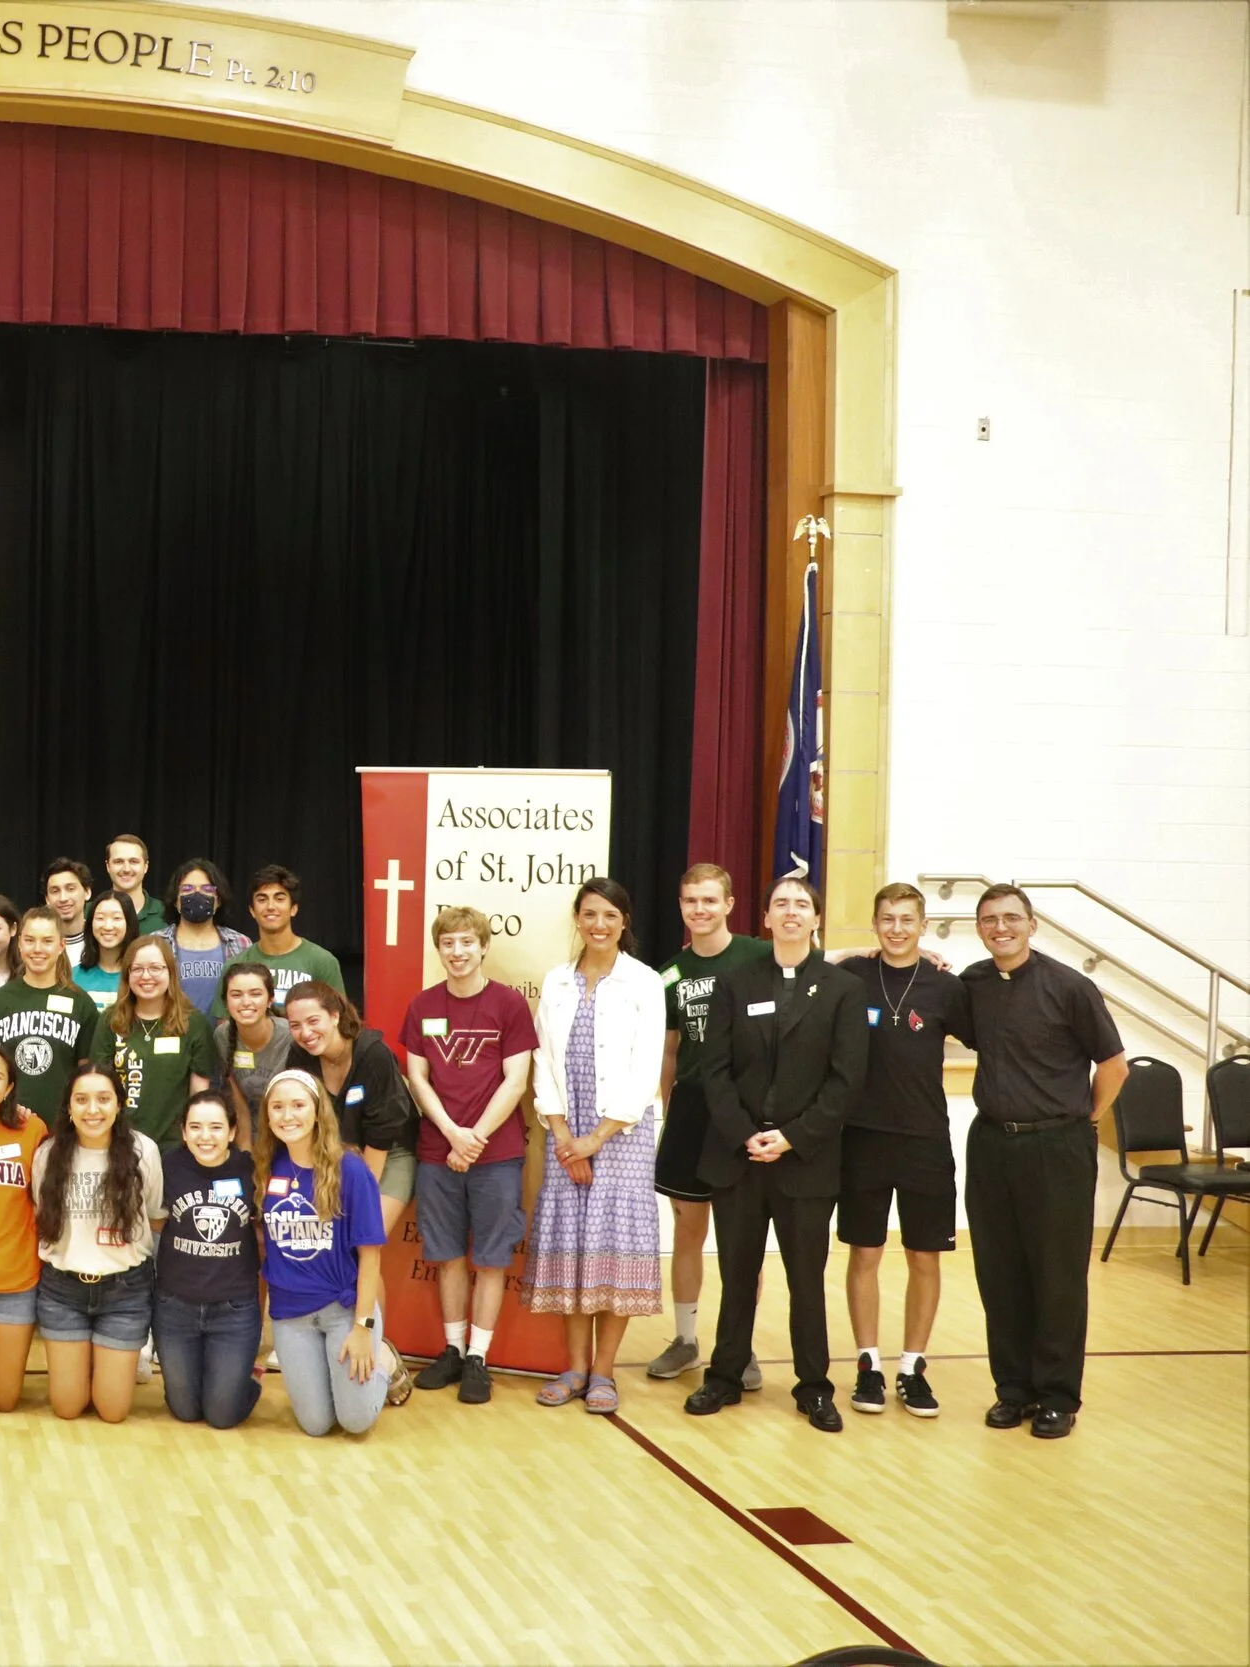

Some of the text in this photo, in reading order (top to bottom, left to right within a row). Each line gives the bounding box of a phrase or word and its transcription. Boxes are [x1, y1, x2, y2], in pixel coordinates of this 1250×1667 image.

[37, 23, 214, 78] PEOPLE
[266, 65, 317, 94] 2:10
[437, 798, 594, 831] Associates
[436, 850, 596, 892] of St. John
[126, 1058, 143, 1109] PRIDE
[172, 1190, 203, 1223] JOHNS
[173, 1236, 241, 1257] UNIVERSITY
[267, 1221, 333, 1241] APTAINS
